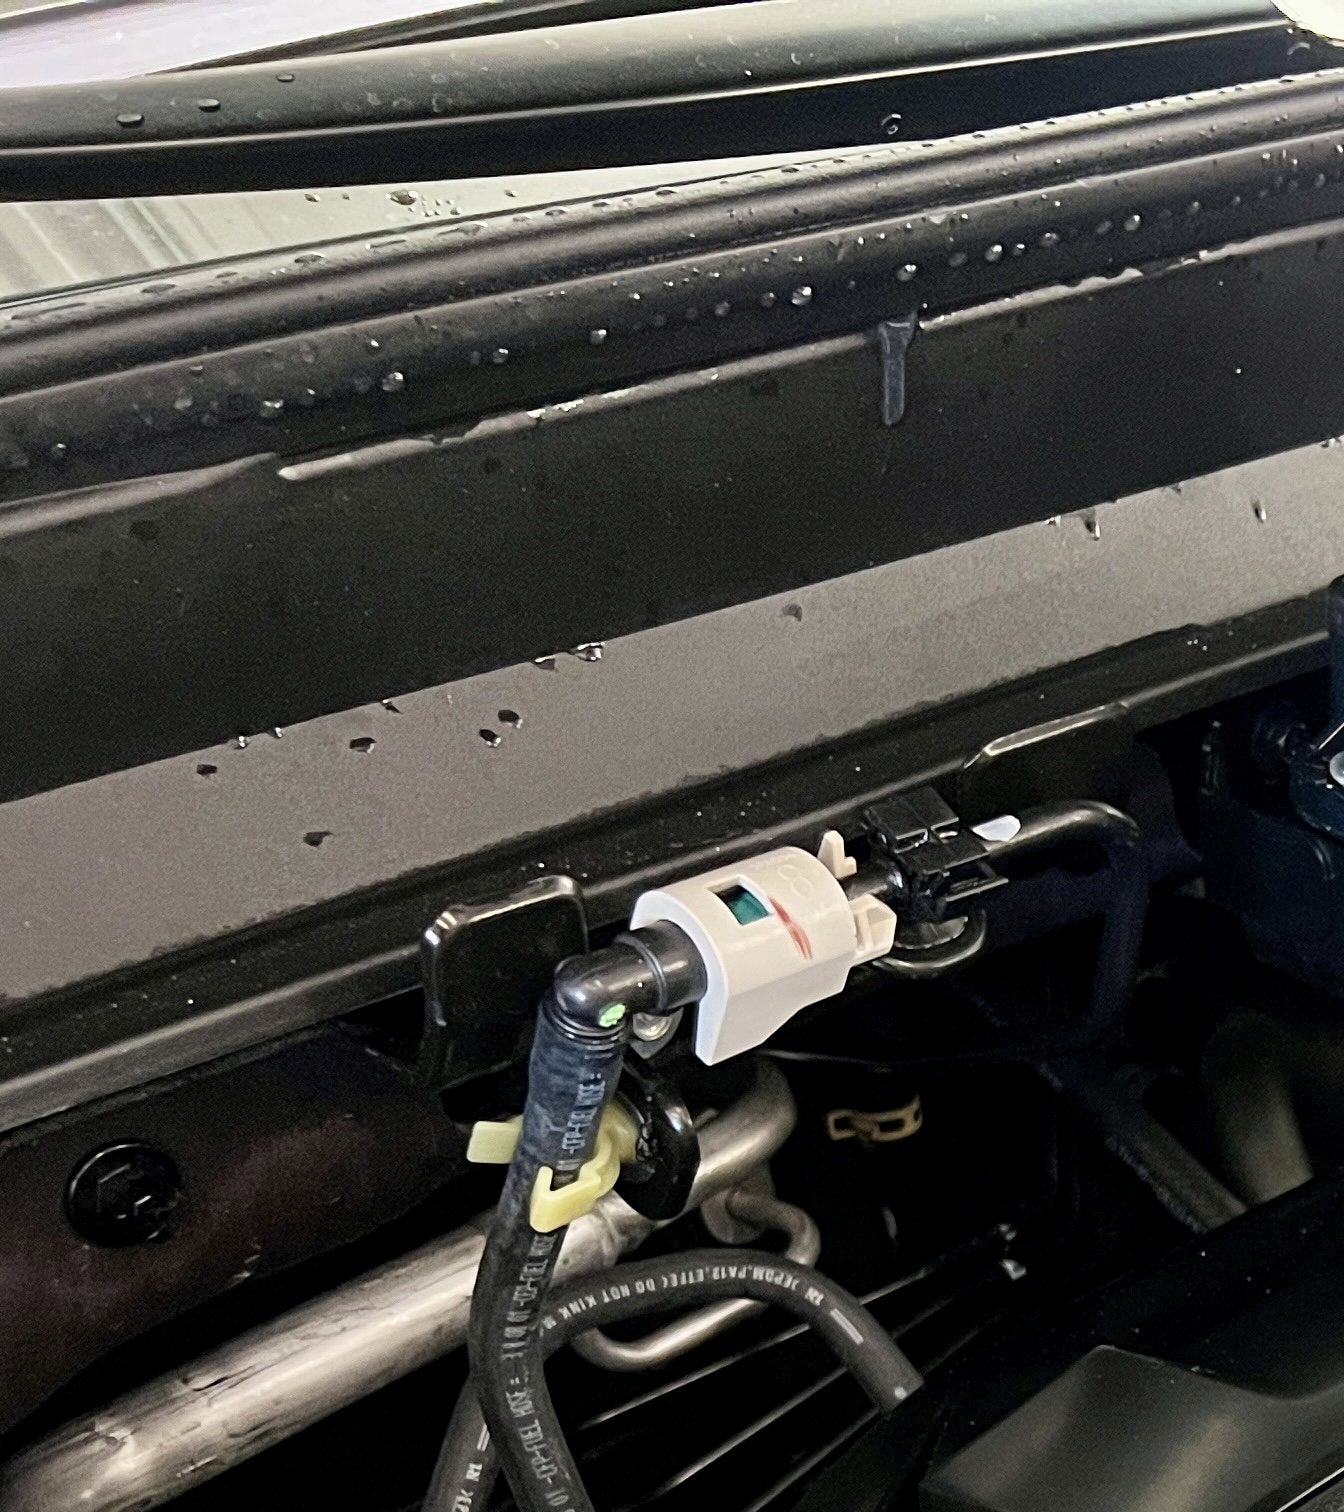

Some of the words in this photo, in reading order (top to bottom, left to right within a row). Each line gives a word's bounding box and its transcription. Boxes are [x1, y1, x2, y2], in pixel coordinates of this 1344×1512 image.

[602, 1284, 631, 1303] NOT
[635, 1278, 656, 1295] DO
[558, 1294, 598, 1320] KINK
